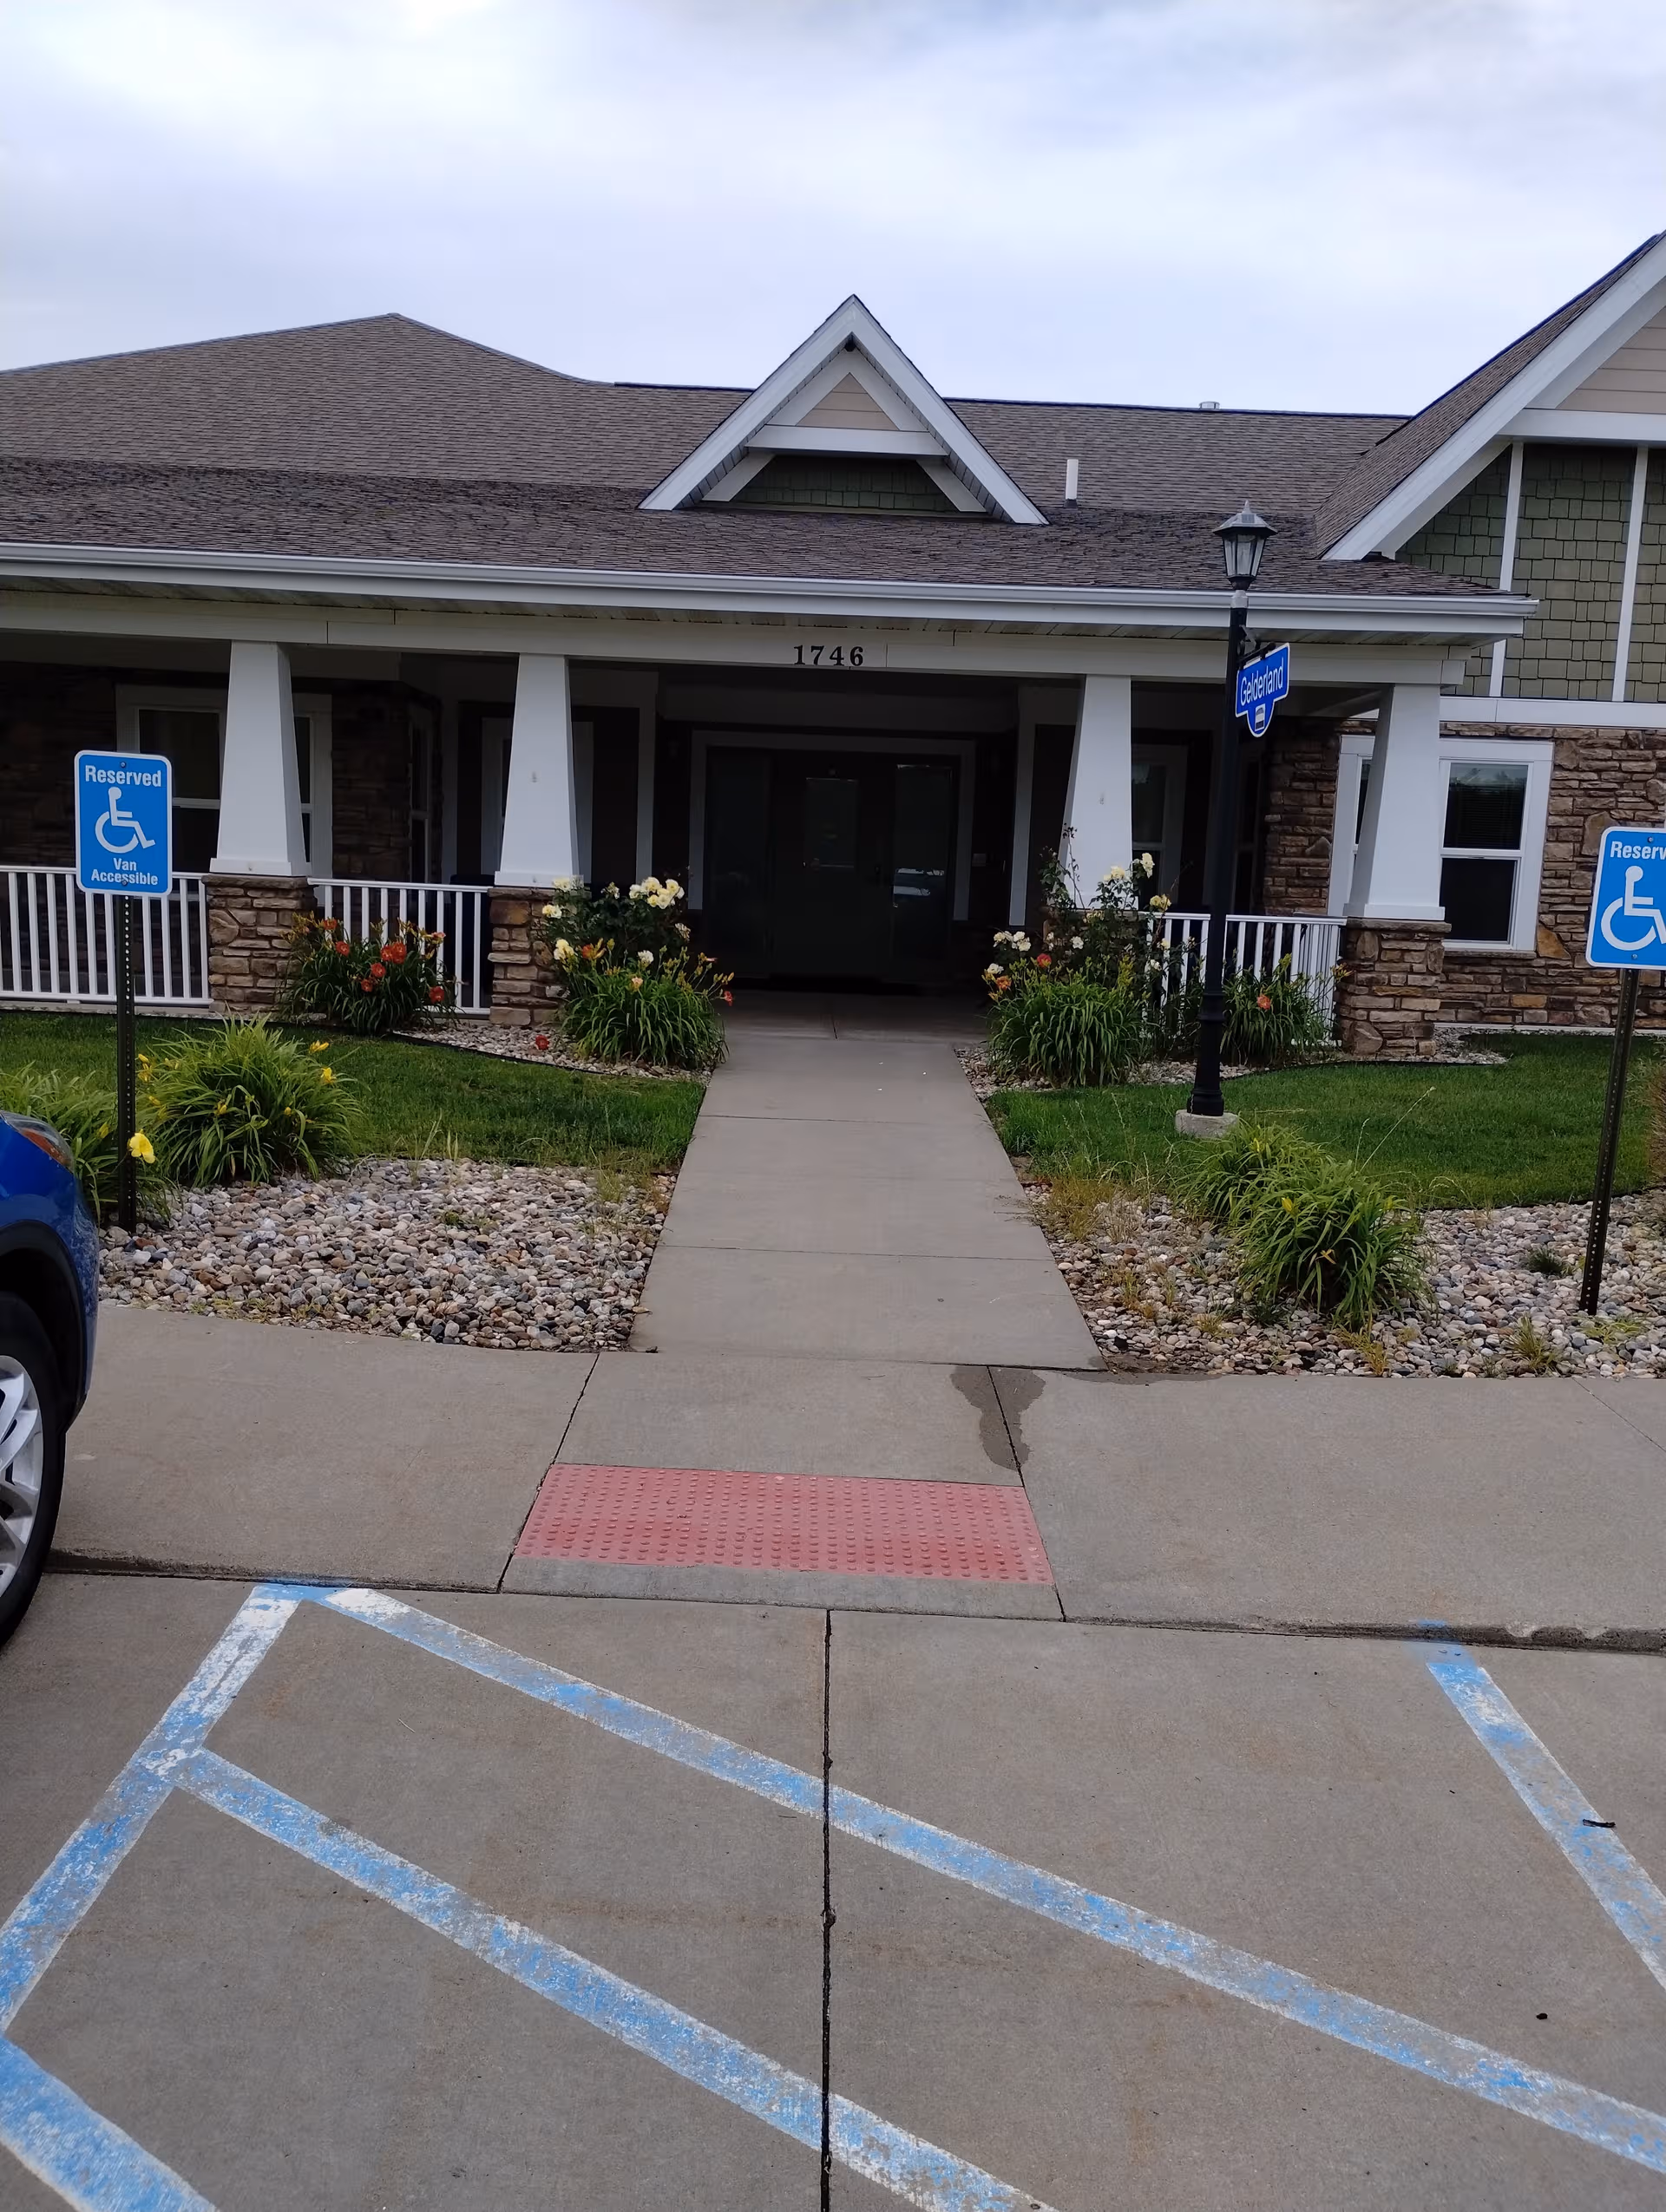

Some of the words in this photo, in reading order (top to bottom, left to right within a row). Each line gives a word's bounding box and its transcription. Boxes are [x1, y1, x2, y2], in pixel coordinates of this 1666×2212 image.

[793, 645, 863, 667] 1746
[1240, 656, 1284, 706] Gelderland
[84, 764, 161, 788] Reserved
[113, 857, 137, 872] Van
[90, 868, 159, 886] Accessible
